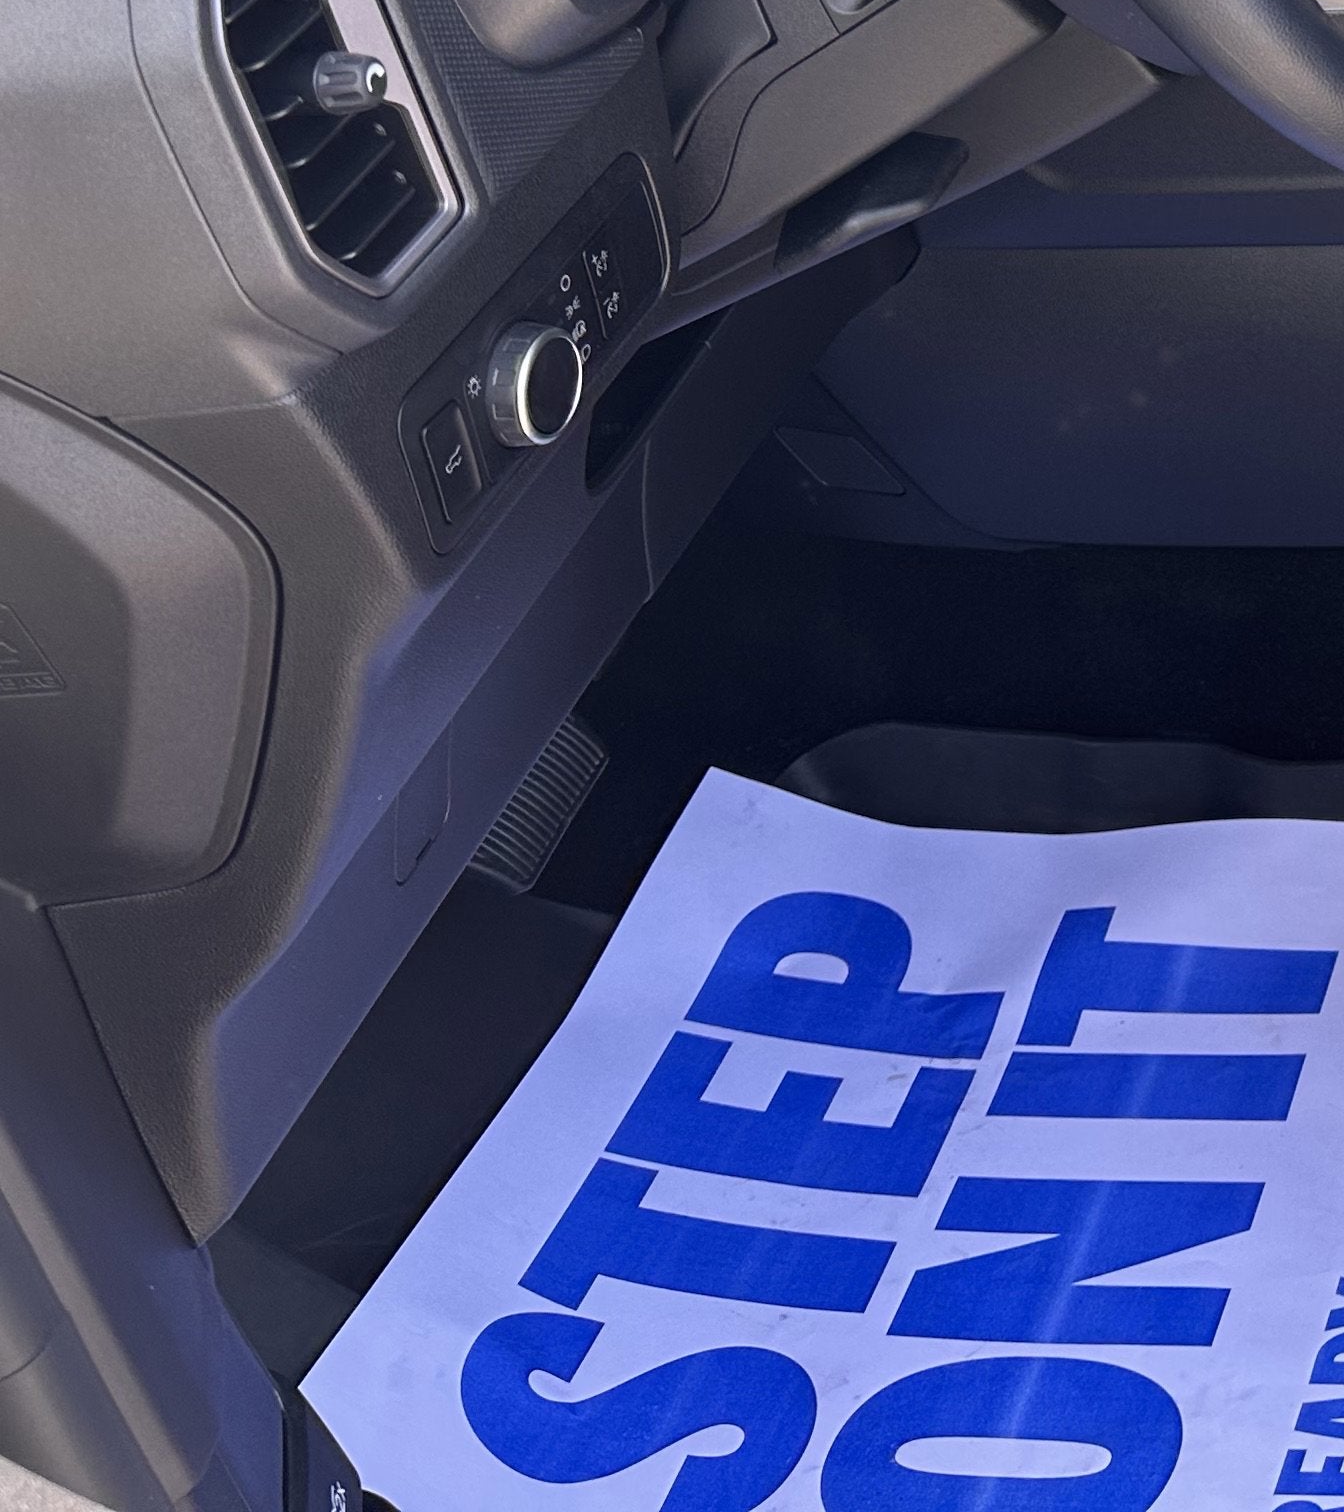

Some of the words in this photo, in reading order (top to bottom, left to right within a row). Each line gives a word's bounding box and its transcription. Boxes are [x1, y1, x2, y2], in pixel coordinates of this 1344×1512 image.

[985, 906, 1339, 1122] IT
[460, 891, 1006, 1512] STEP
[820, 1176, 1266, 1512] ON
